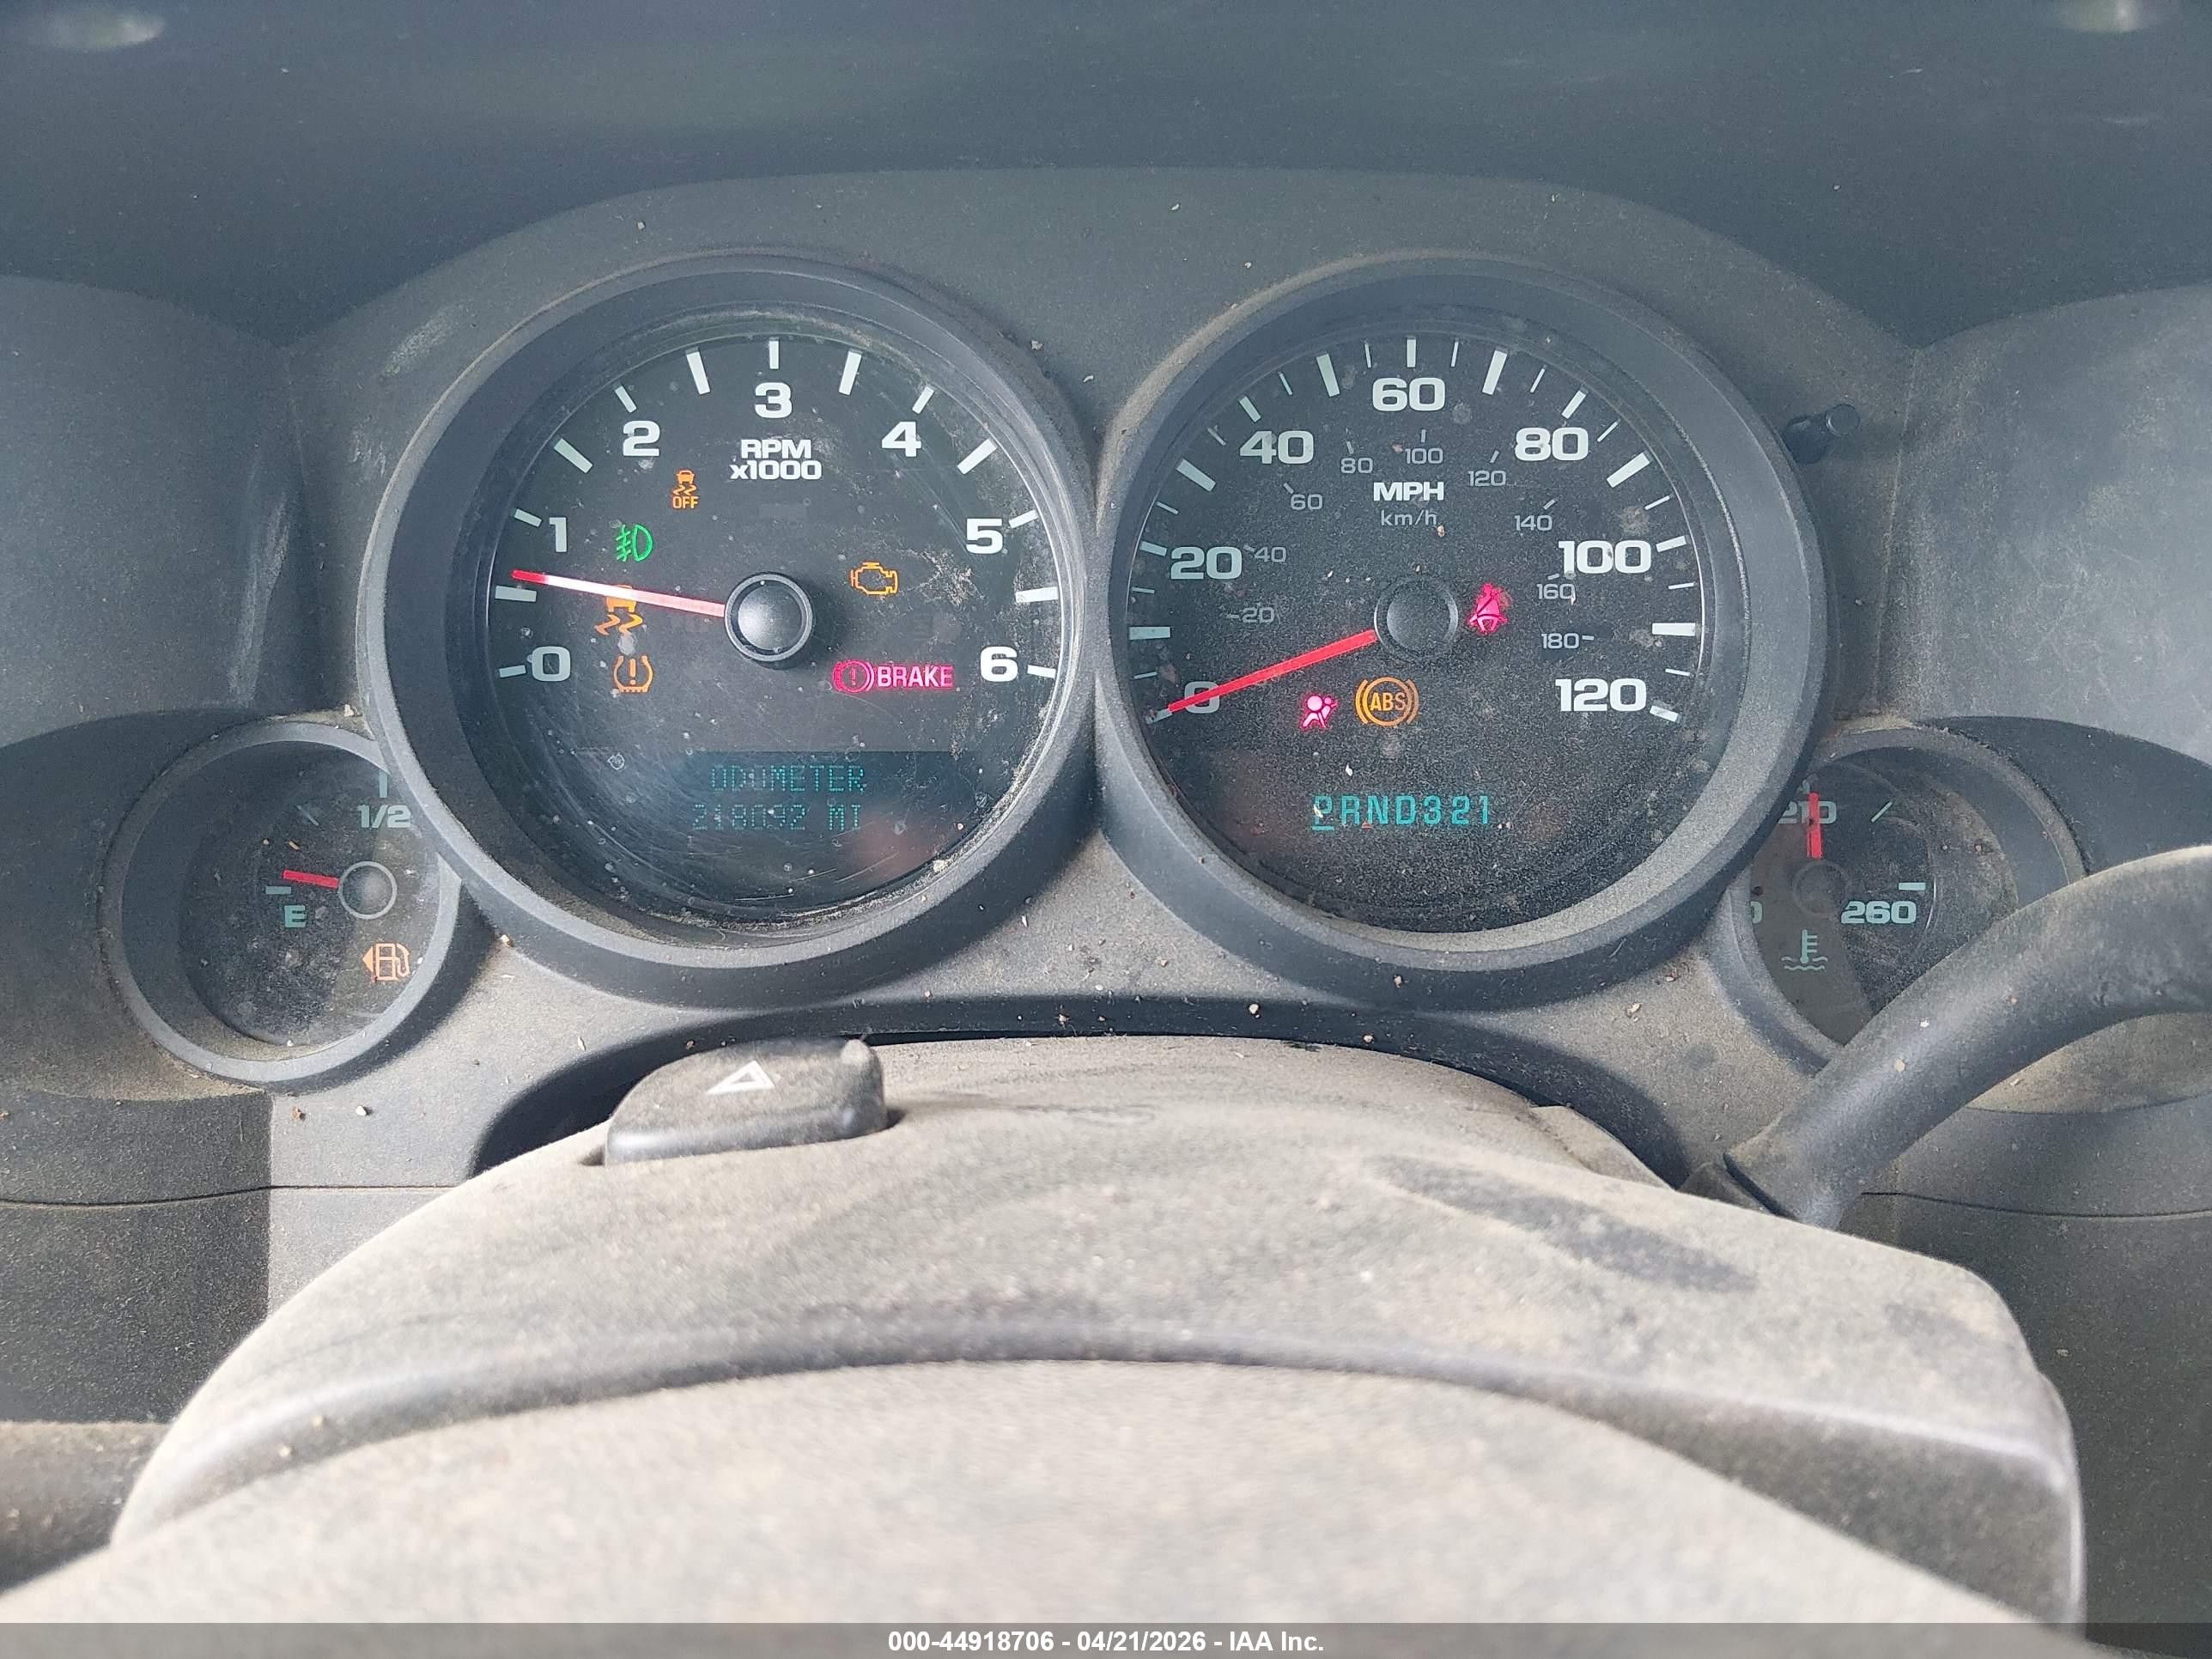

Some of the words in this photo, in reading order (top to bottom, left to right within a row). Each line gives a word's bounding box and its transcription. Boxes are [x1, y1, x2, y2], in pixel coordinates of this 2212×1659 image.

[755, 382, 793, 418] 3
[1373, 378, 1445, 411] 60
[623, 421, 659, 457] 2
[741, 439, 811, 459] RPM
[882, 422, 921, 457] 4
[1240, 430, 1314, 465] 40
[1515, 427, 1589, 461] 80
[1340, 458, 1373, 474] 80
[1406, 447, 1443, 465] 100
[730, 460, 822, 480] x1000
[1468, 471, 1506, 487] 120
[672, 495, 699, 508] OFF
[1291, 495, 1322, 510] 60
[1373, 482, 1444, 501] MPH
[1381, 510, 1437, 526] km/h
[1515, 515, 1553, 532] 140
[550, 517, 567, 552] 1
[966, 519, 1003, 554] 5
[1171, 547, 1242, 580] 20
[1254, 547, 1286, 562] 40
[1558, 541, 1651, 574] 100
[1537, 585, 1575, 600] 160
[1241, 607, 1275, 623] 20
[1541, 633, 1579, 649] 180
[532, 647, 570, 682] 0
[980, 647, 1018, 682] 6
[877, 666, 953, 688] BRAKE
[1370, 692, 1406, 711] ABS
[1555, 678, 1647, 712] 120
[710, 765, 865, 791] ODOMETER
[357, 805, 411, 828] 1/2
[829, 805, 861, 830] MI
[284, 905, 306, 927] E
[1841, 901, 1916, 923] 260
